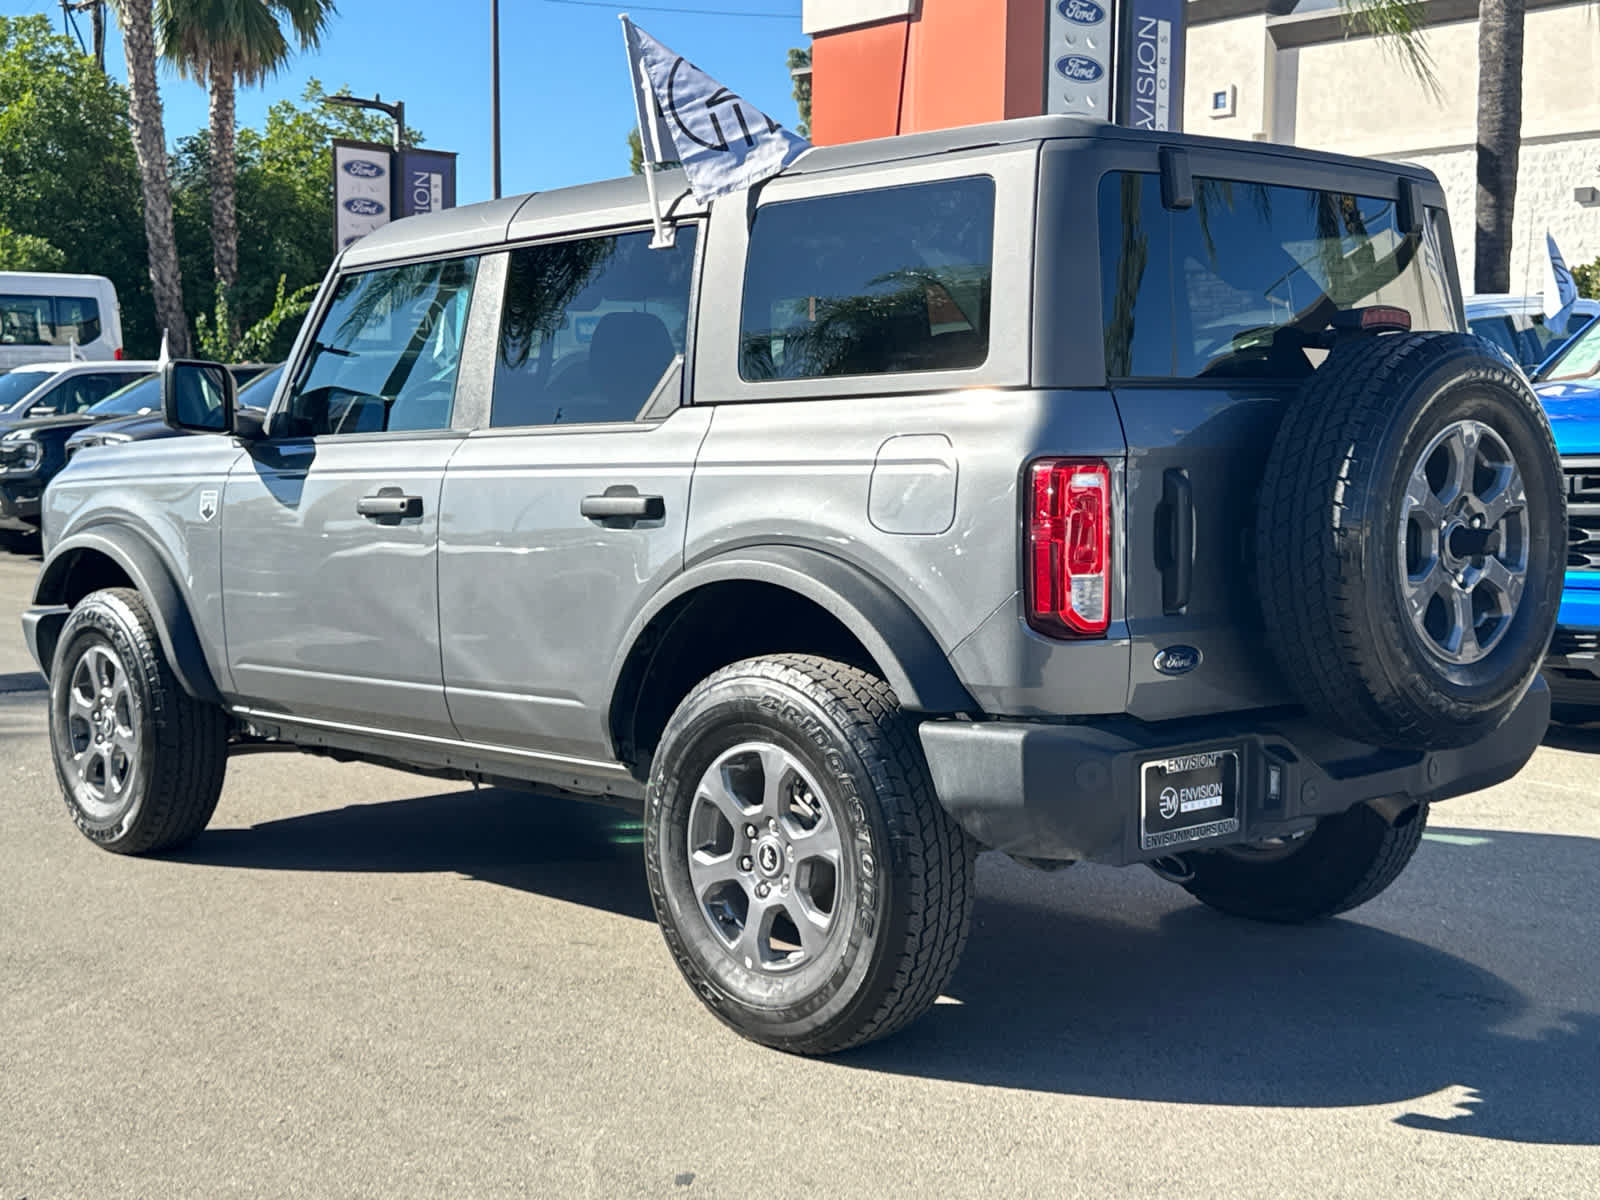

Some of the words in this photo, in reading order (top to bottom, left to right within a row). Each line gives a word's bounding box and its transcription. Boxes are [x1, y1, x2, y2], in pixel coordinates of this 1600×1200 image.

[1065, 0, 1096, 21] Ford
[1064, 58, 1095, 79] Ford
[350, 162, 377, 177] Ford
[350, 200, 378, 215] Ford
[1168, 755, 1217, 772] ENVISION
[1180, 782, 1223, 802] ENVISION
[757, 695, 877, 938] BRIDGESTONE
